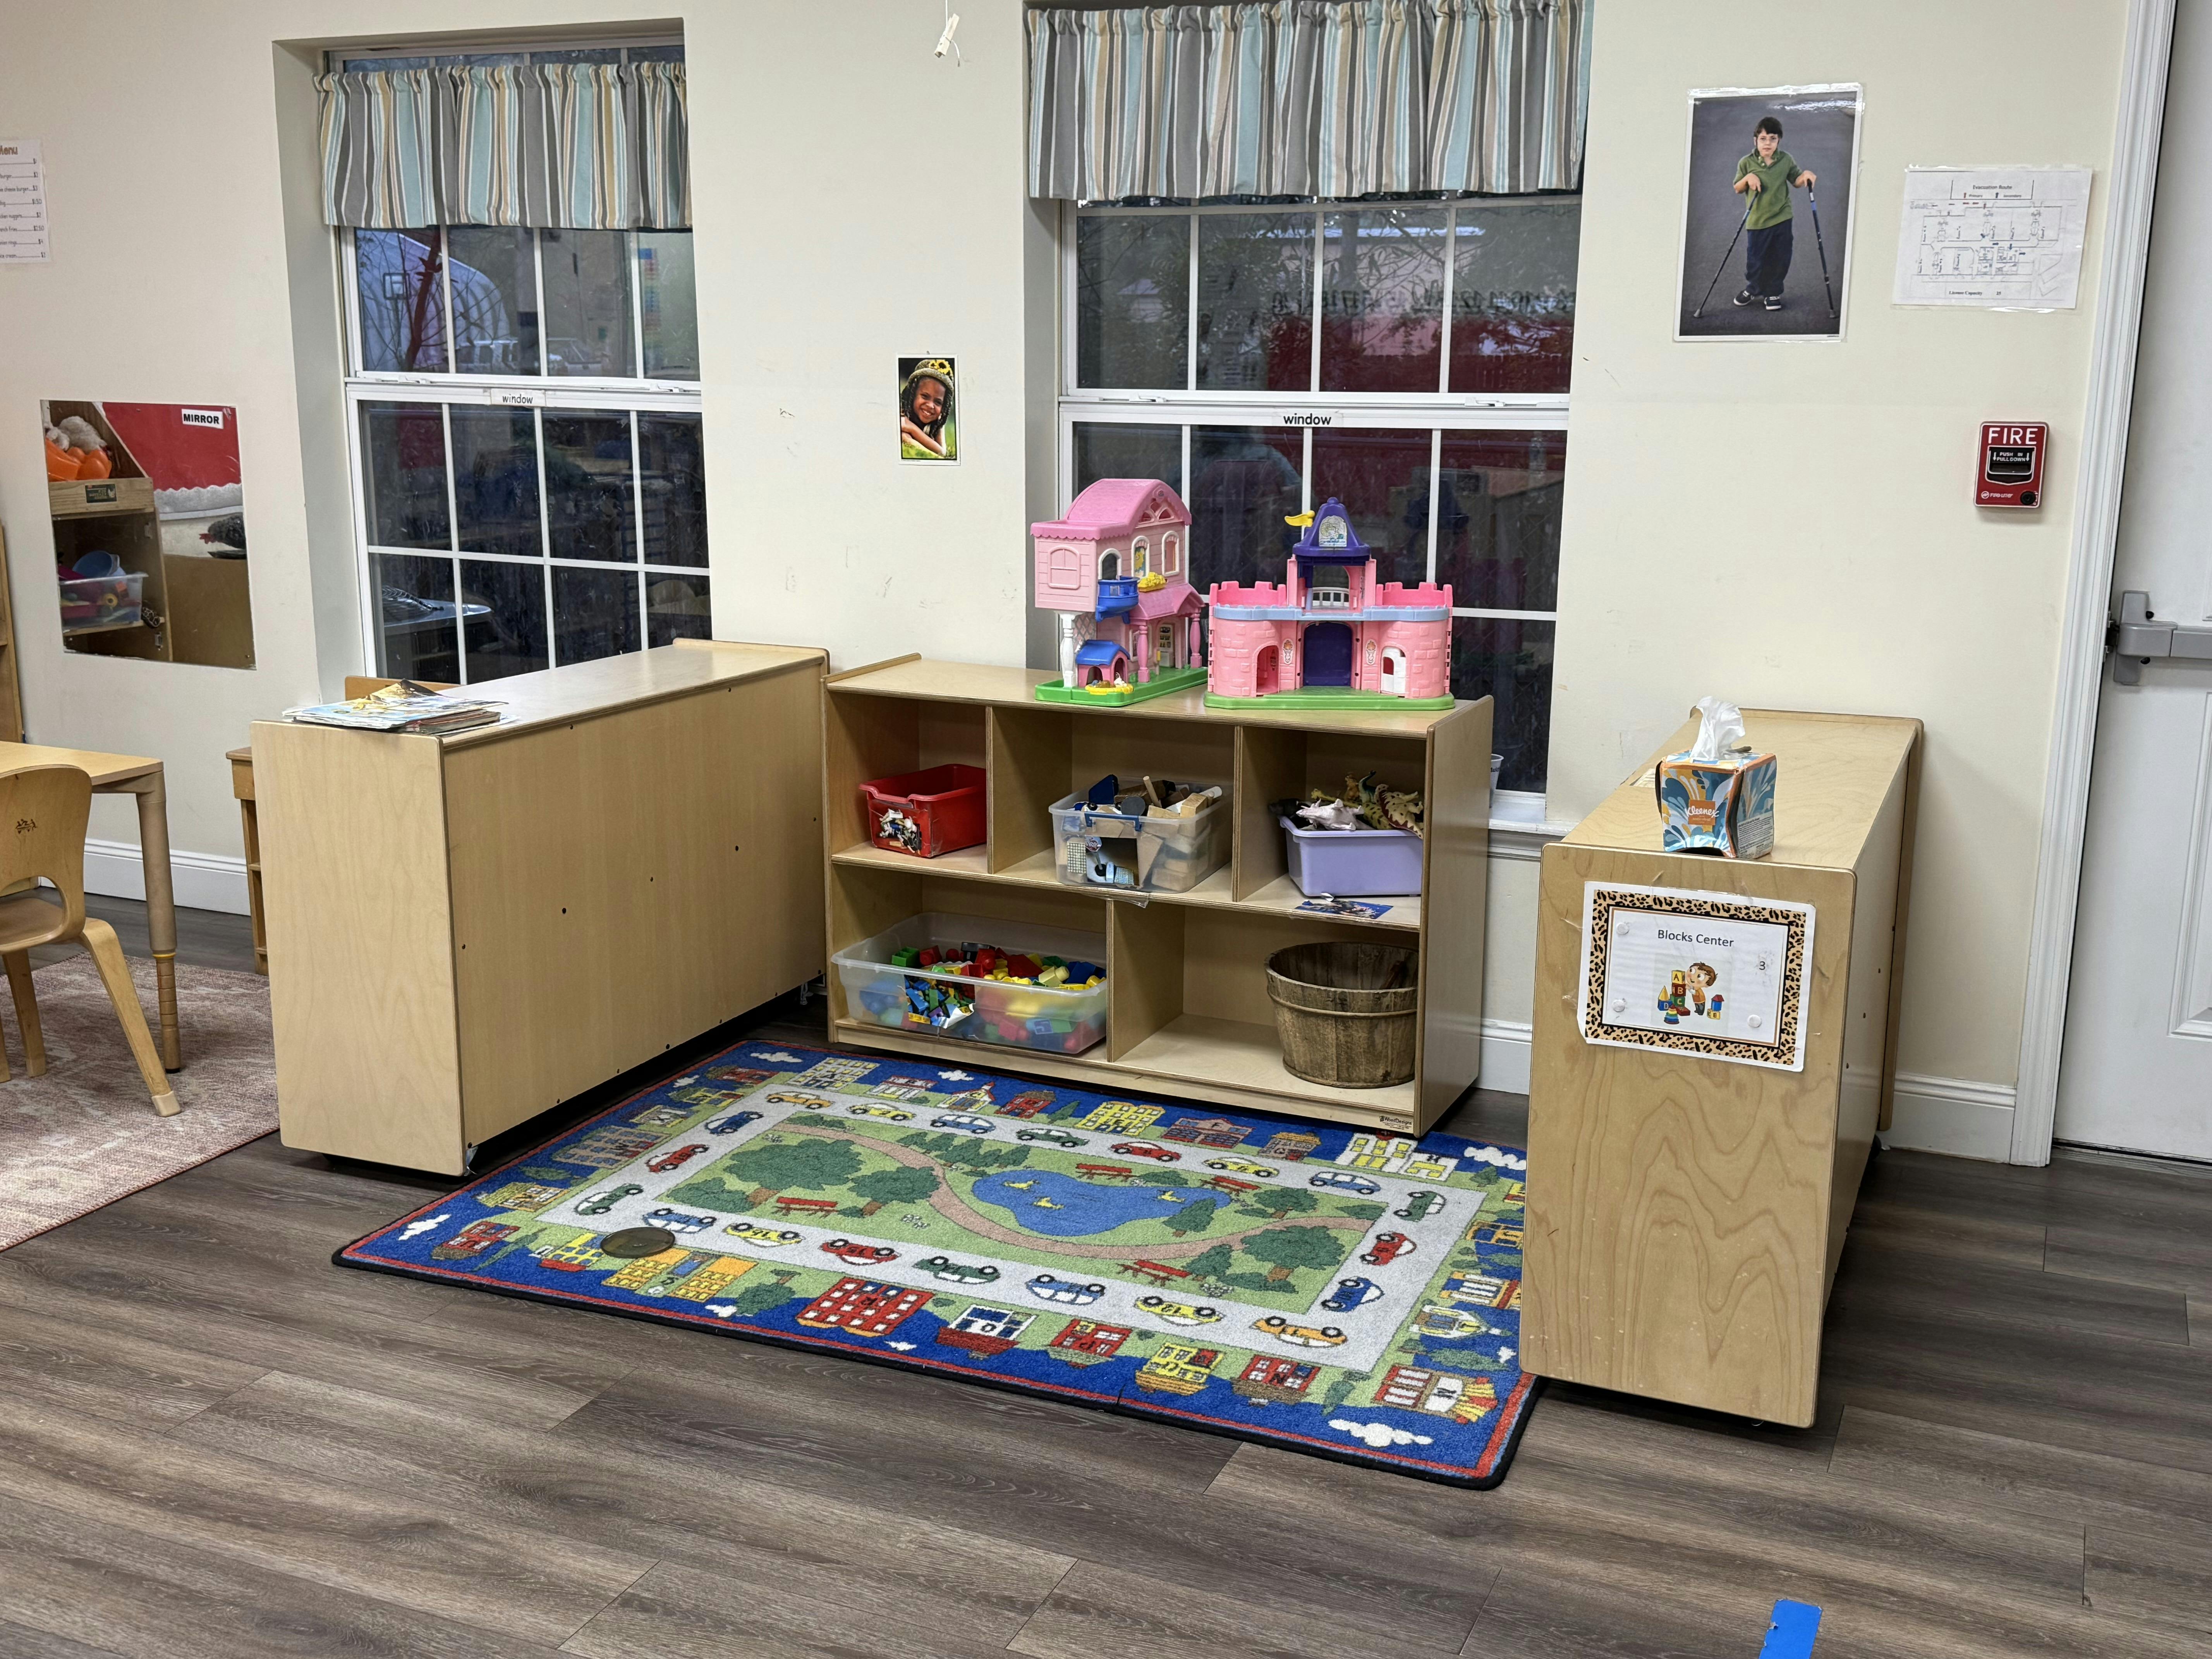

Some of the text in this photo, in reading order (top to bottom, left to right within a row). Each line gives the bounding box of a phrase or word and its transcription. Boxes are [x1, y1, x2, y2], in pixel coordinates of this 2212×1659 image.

[503, 393, 533, 404] window
[184, 414, 220, 424] MIRROR
[1283, 413, 1324, 425] window
[1988, 427, 2038, 445] FIRE
[1684, 805, 1719, 818] Kleenex
[1658, 929, 1734, 947] Blocks Center
[1759, 961, 1766, 970] 3
[1673, 973, 1680, 981] A
[980, 1323, 997, 1333] O
